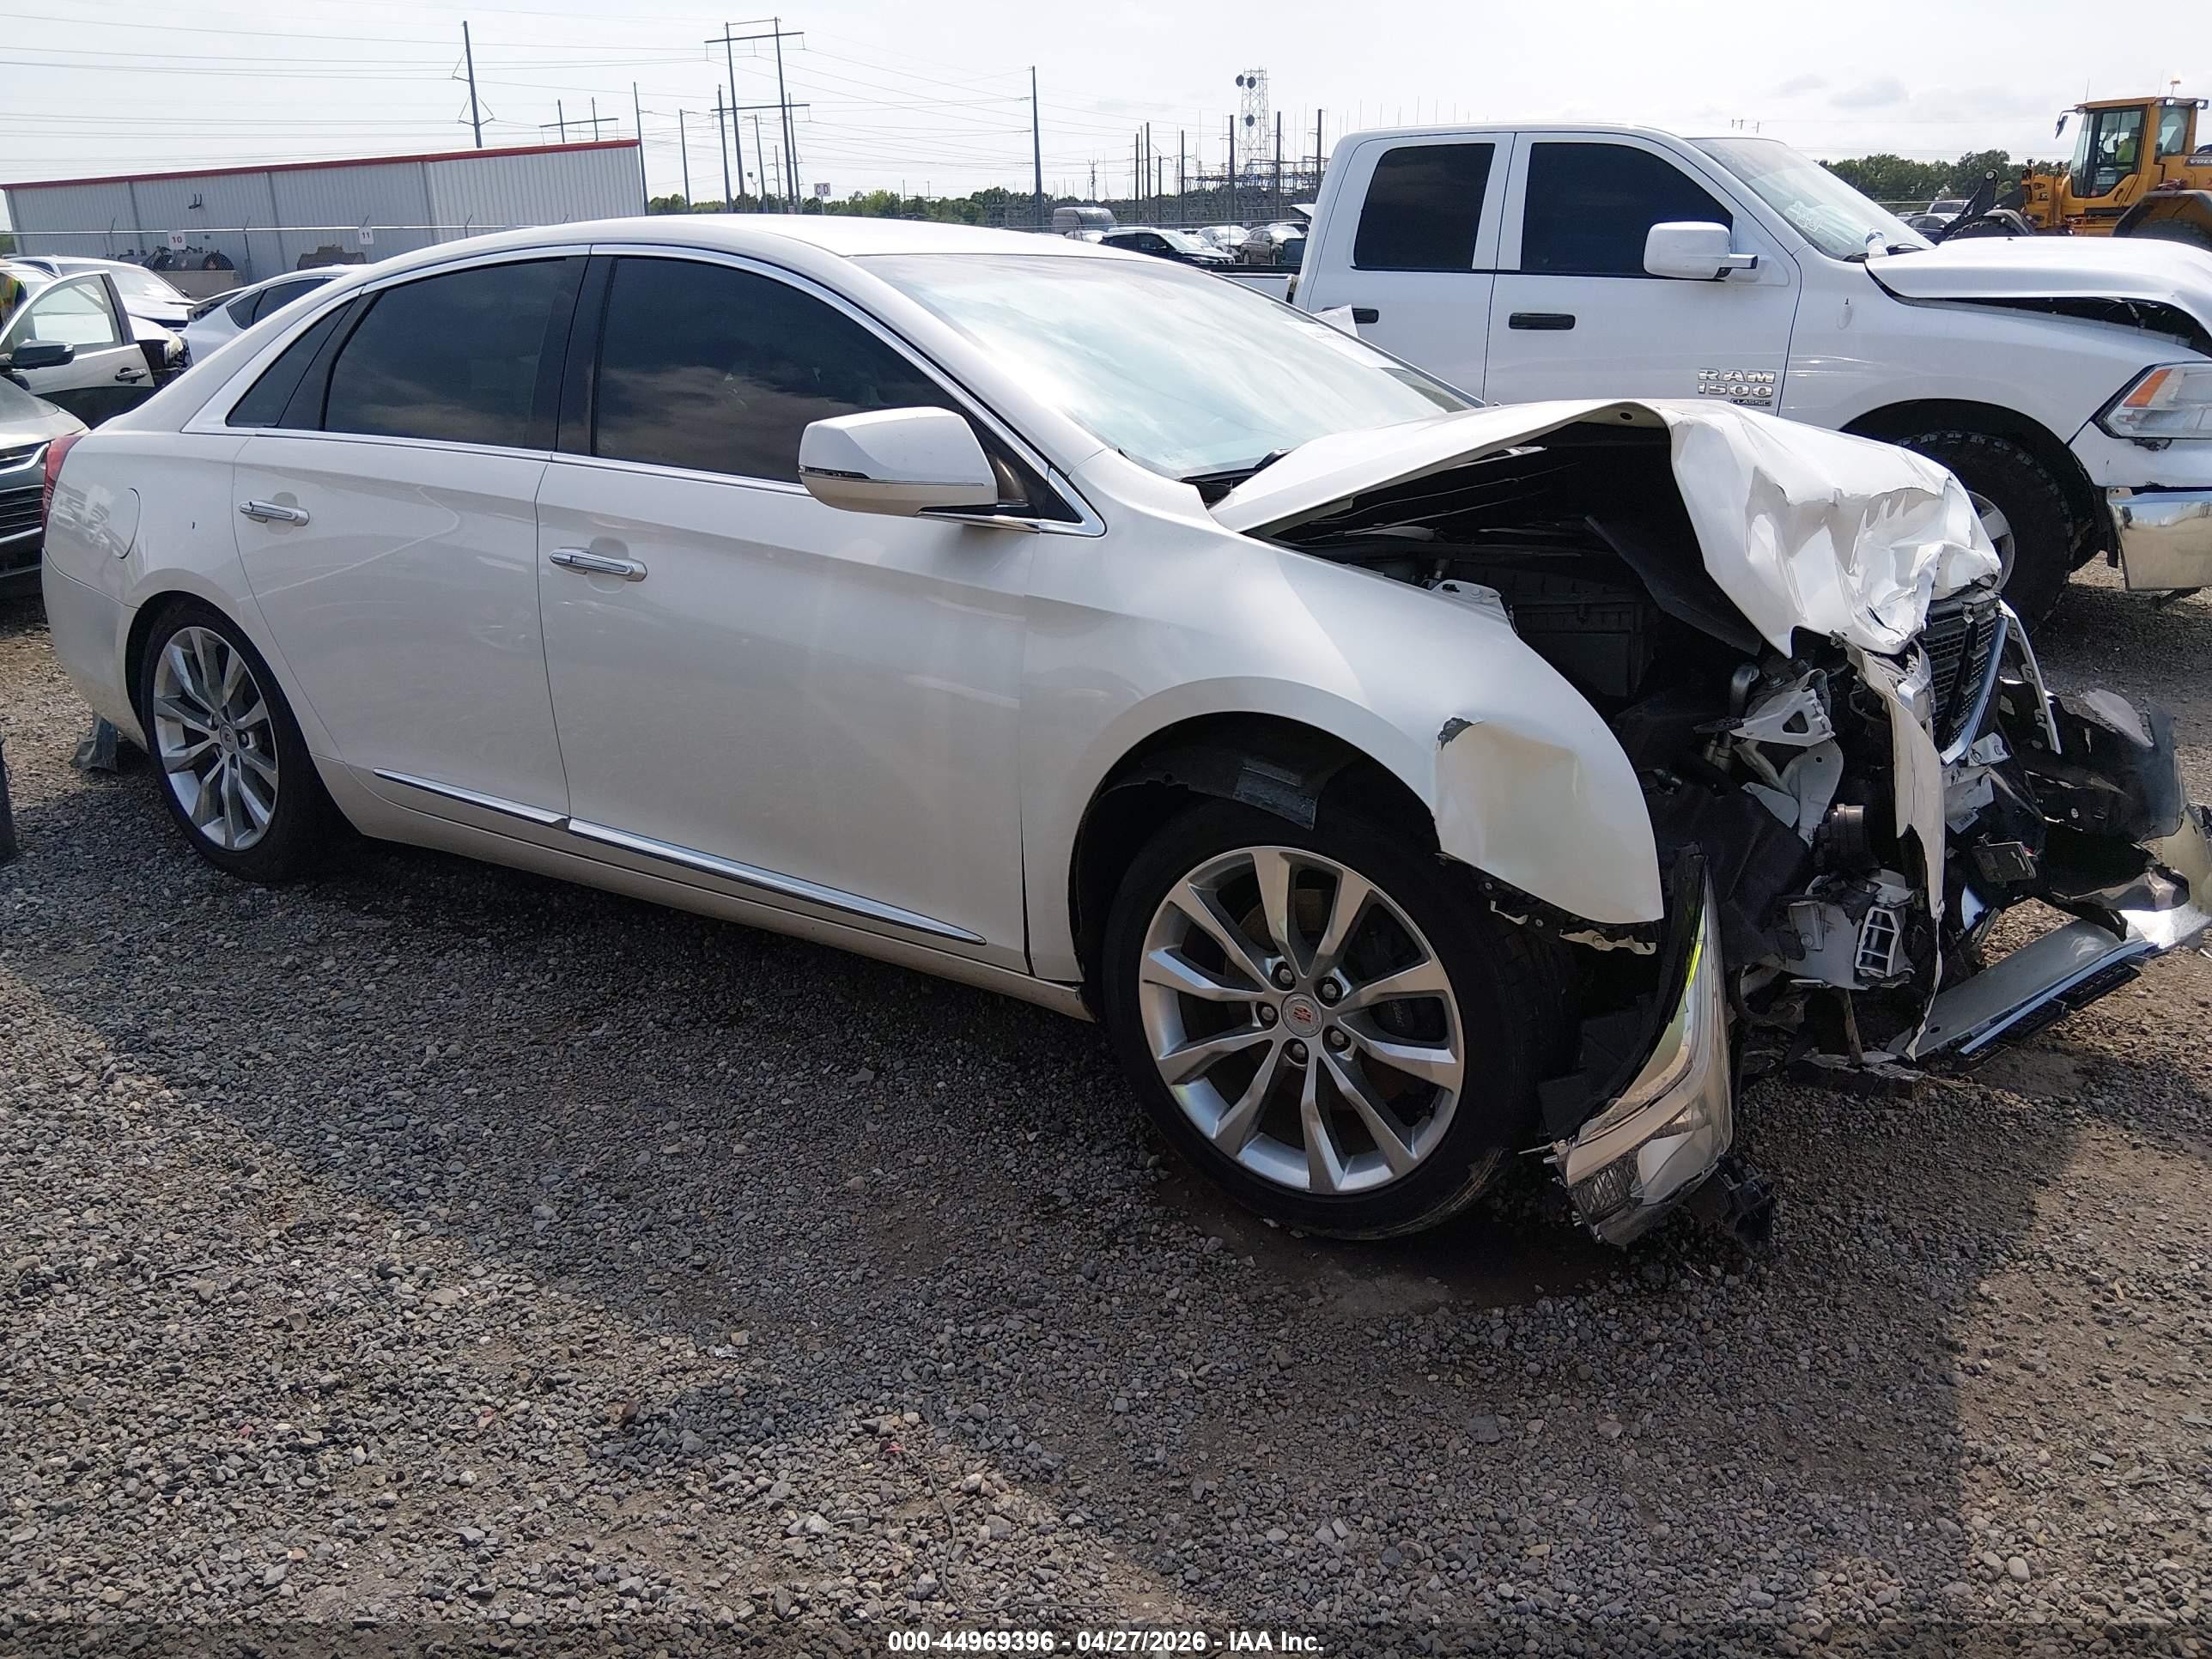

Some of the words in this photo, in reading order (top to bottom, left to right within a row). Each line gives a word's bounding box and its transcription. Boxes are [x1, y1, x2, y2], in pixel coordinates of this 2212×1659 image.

[172, 235, 183, 244] 10
[1698, 368, 1776, 384] RAM
[1698, 382, 1773, 398] 1500
